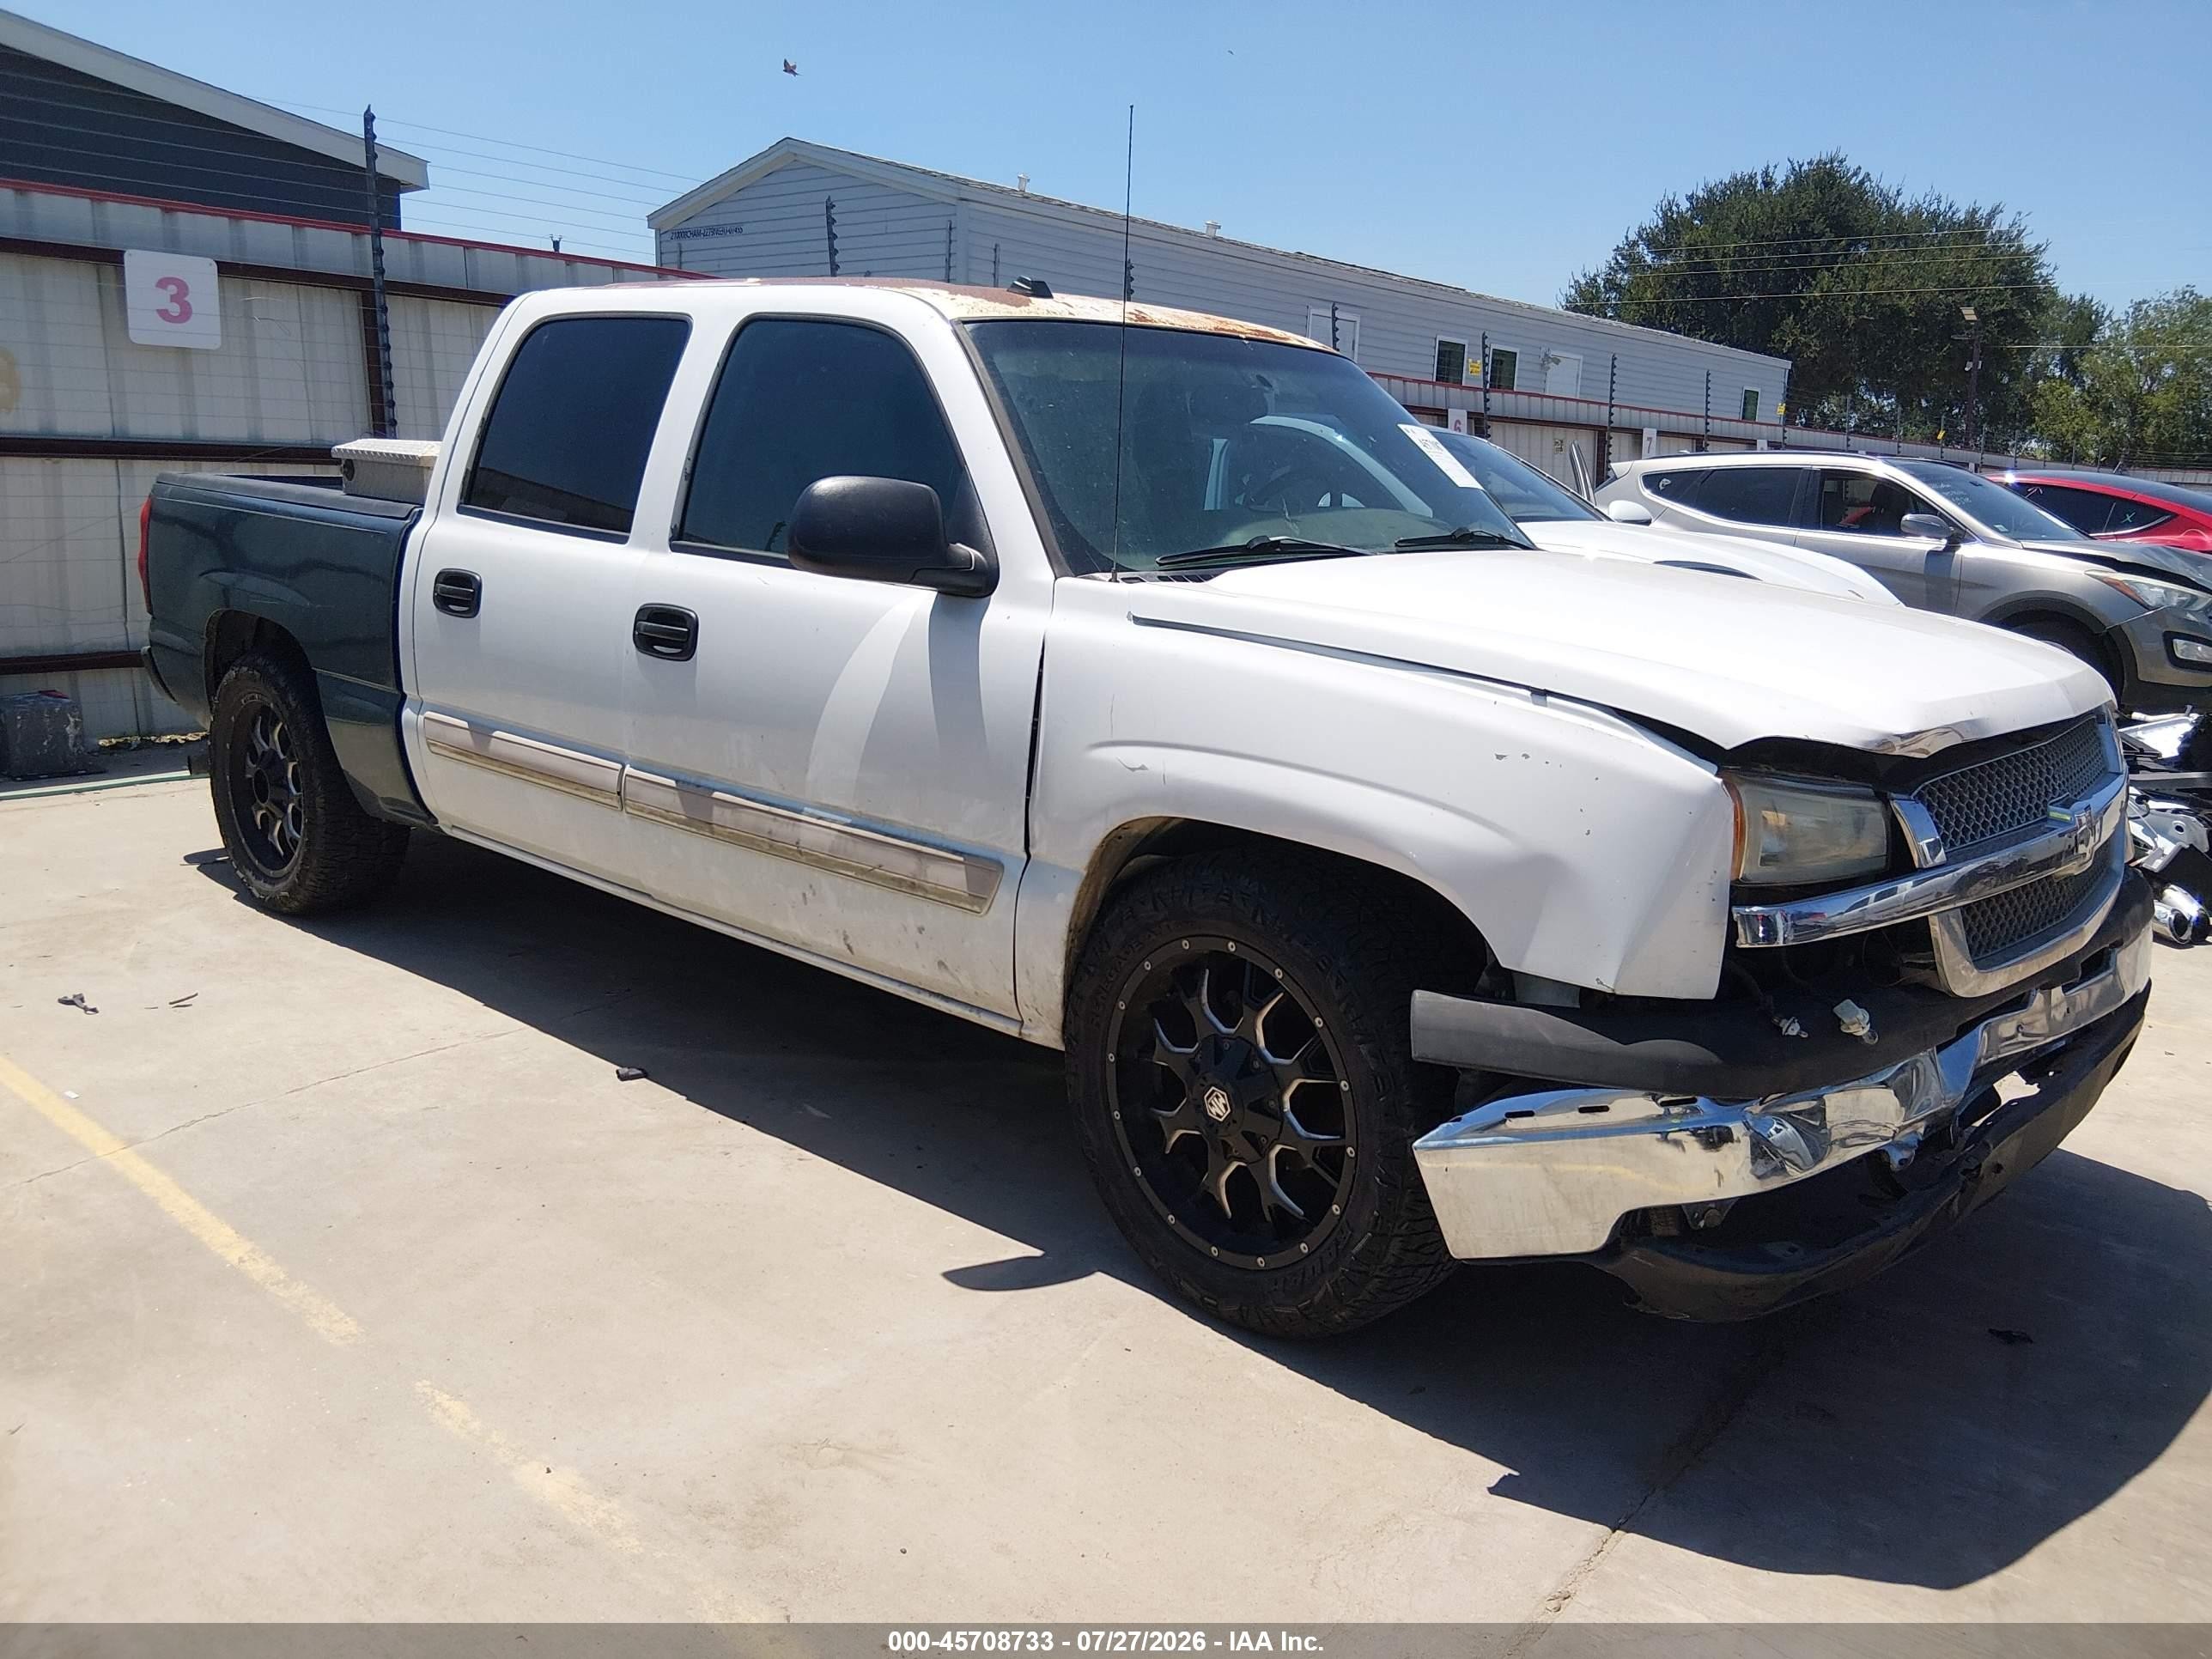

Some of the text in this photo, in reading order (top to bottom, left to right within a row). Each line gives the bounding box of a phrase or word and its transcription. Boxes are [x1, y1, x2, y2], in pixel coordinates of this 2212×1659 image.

[155, 276, 192, 324] 3
[1454, 419, 1462, 433] 6
[1646, 437, 1653, 454] 7
